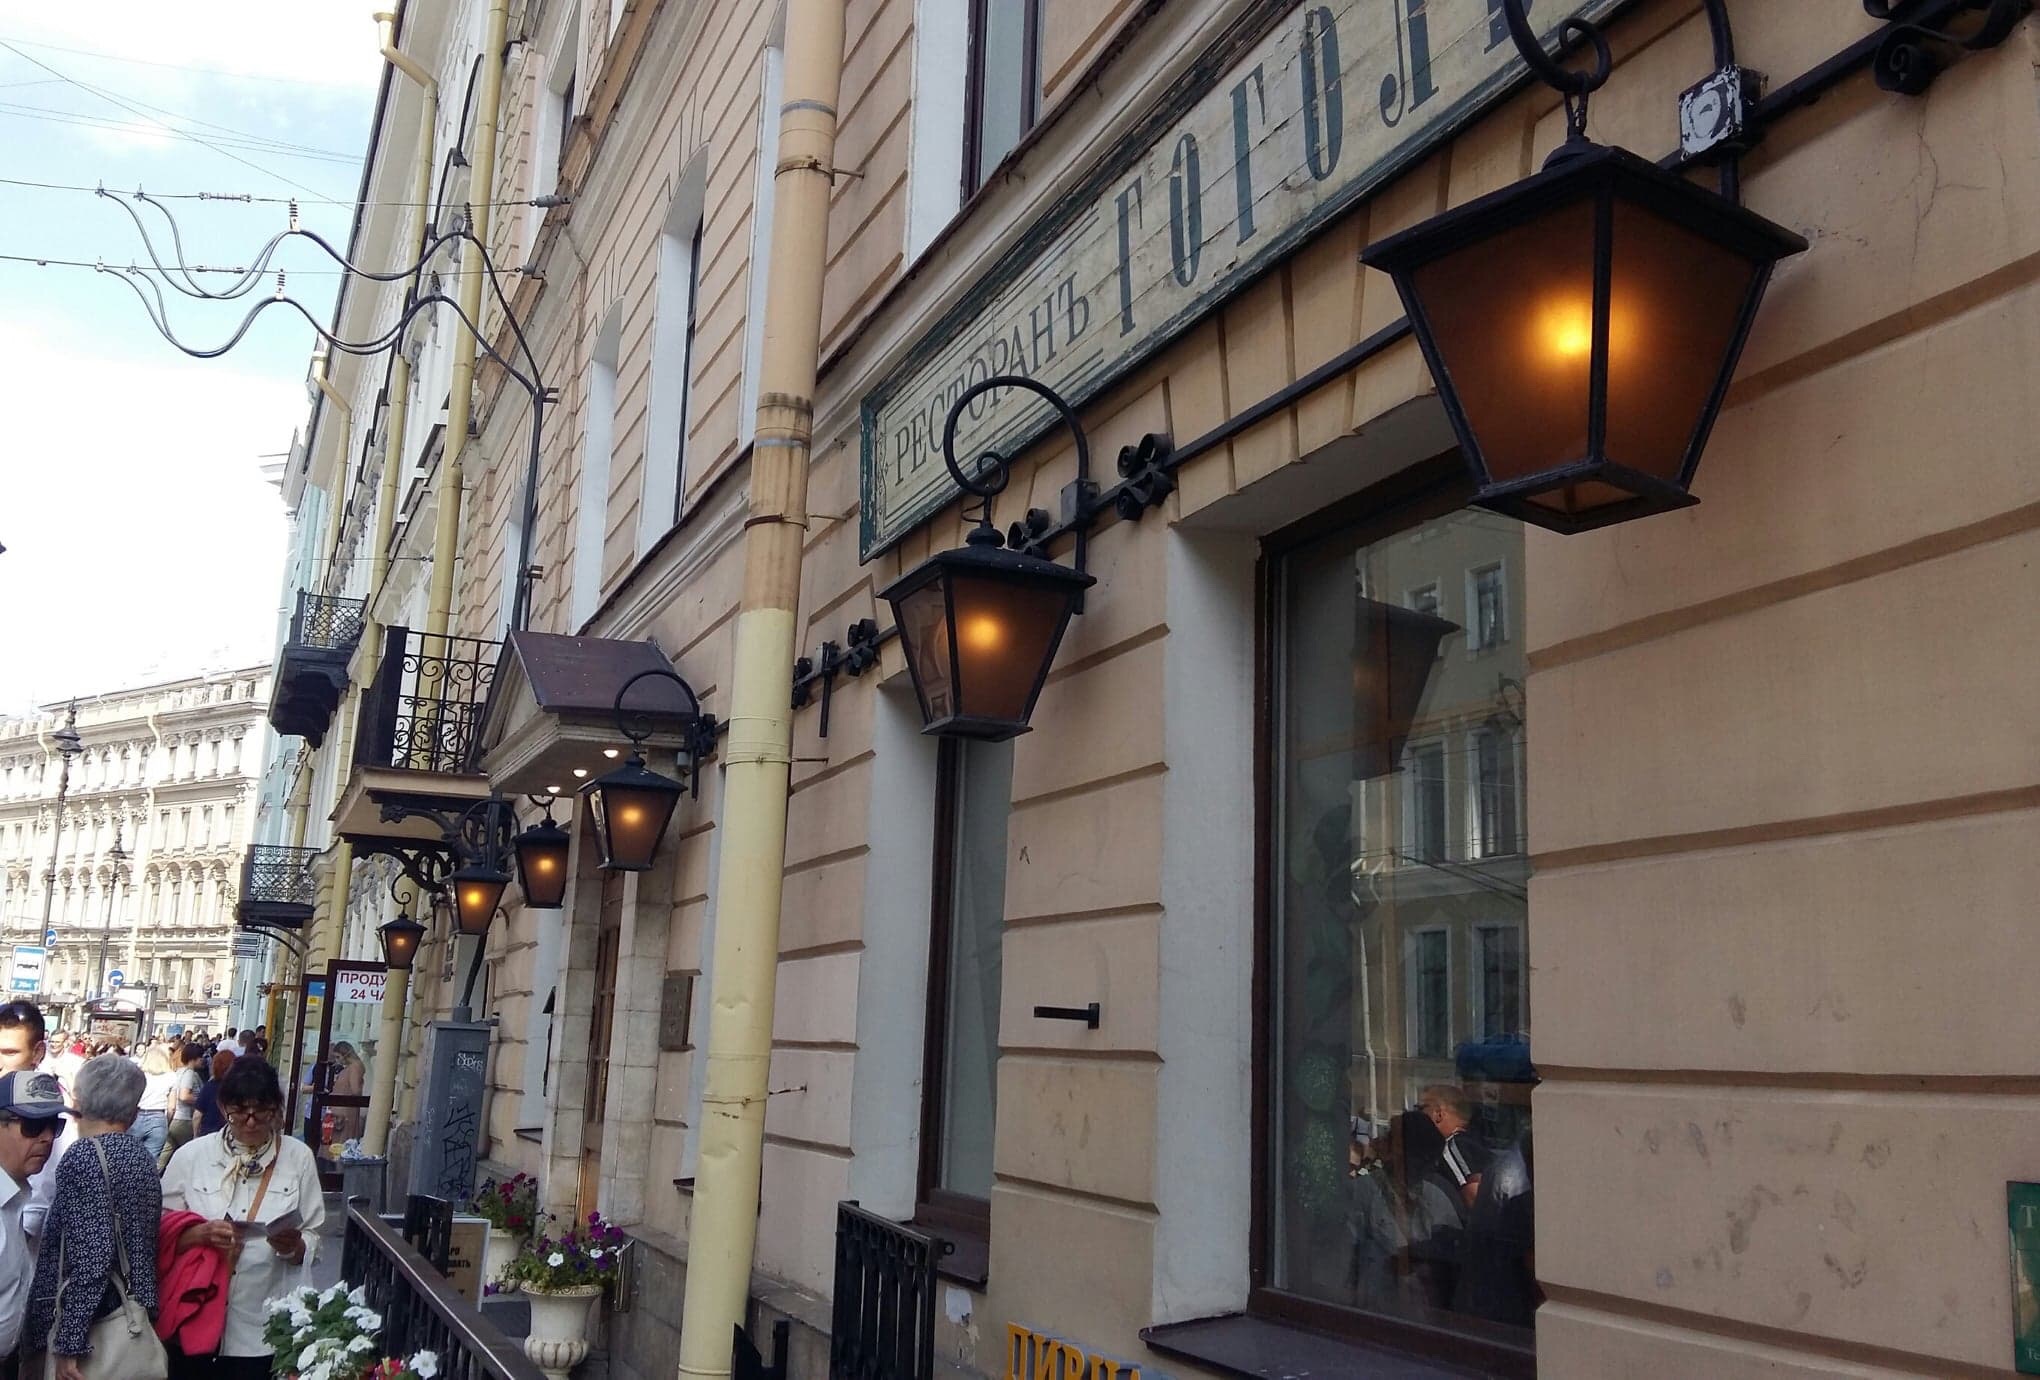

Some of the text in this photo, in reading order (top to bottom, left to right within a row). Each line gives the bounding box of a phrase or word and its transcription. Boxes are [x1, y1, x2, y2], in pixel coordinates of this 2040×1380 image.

[894, 0, 1534, 487] РЕСТОРАНЪ ГОГОЛ
[350, 988, 366, 1000] 24
